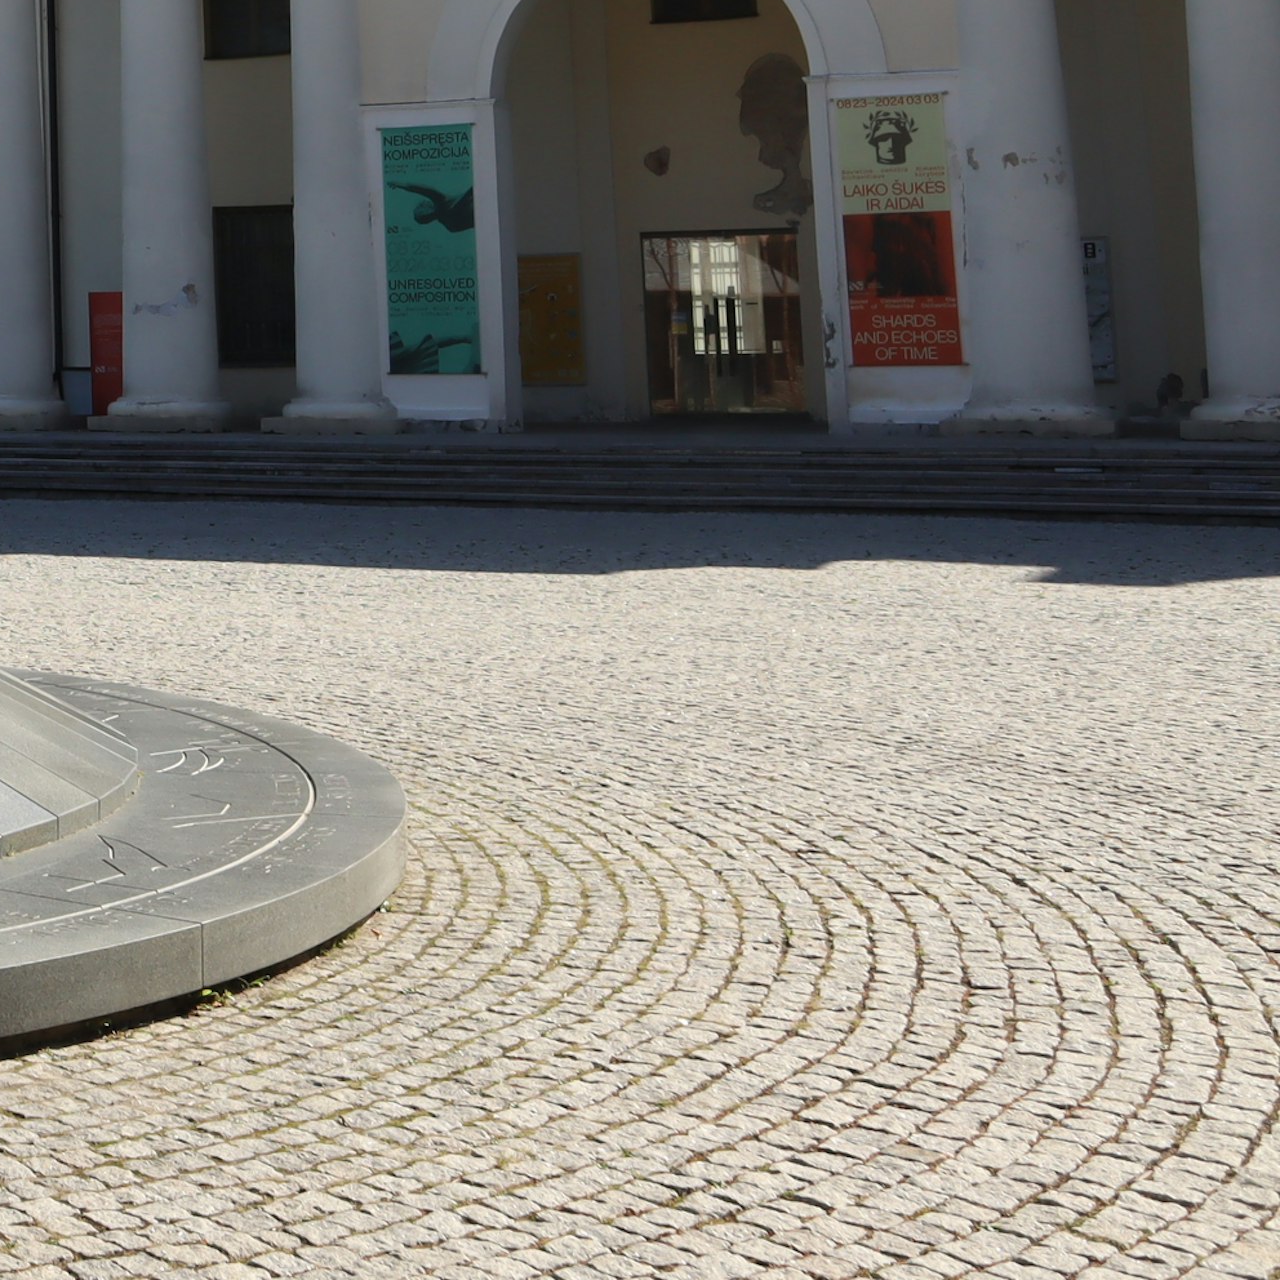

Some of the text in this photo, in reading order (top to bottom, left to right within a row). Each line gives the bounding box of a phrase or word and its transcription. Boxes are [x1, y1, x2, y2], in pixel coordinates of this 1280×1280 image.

[383, 131, 469, 147] NEIŠSPRĘSTA
[384, 145, 470, 161] KOMPOZICIJA
[843, 178, 946, 197] LAIKO ŠUKĖS
[866, 197, 924, 210] IR AIDAI
[388, 277, 475, 290] UNRESOLVED
[388, 290, 476, 304] COMPOSITION
[871, 314, 937, 329] SHARDS
[854, 329, 958, 345] AND ECHOES
[875, 346, 939, 360] OF TIME
